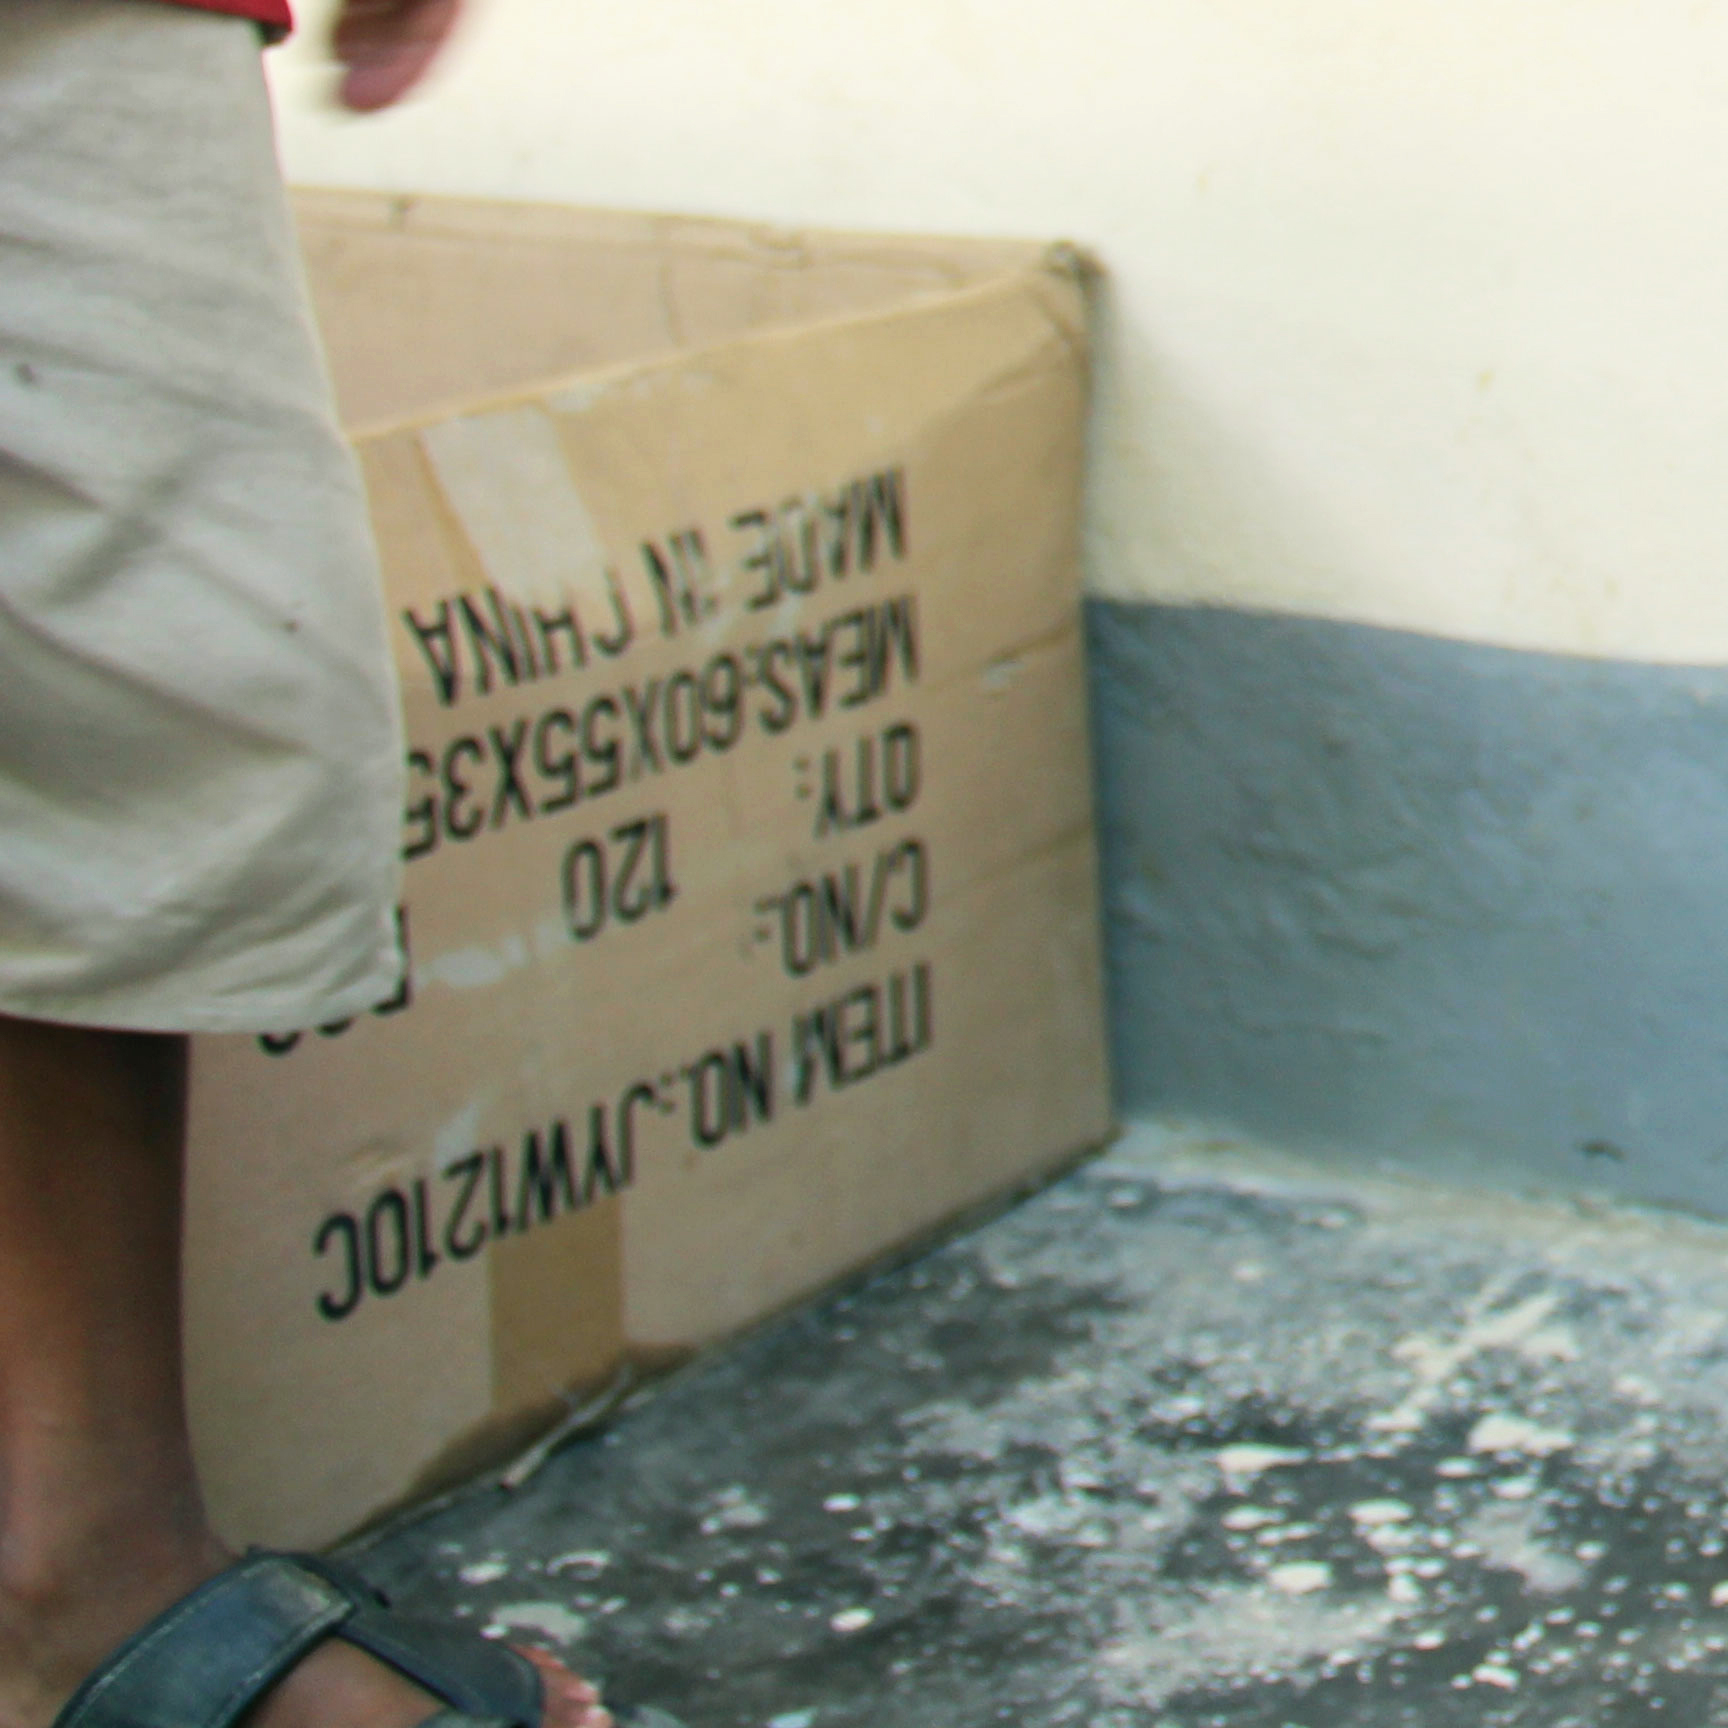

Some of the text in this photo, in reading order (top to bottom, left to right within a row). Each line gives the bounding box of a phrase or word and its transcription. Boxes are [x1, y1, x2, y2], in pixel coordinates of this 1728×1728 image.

[641, 529, 709, 650] IN
[732, 468, 905, 613] MADE
[561, 814, 676, 942] 120
[792, 964, 932, 1110] ITEM
